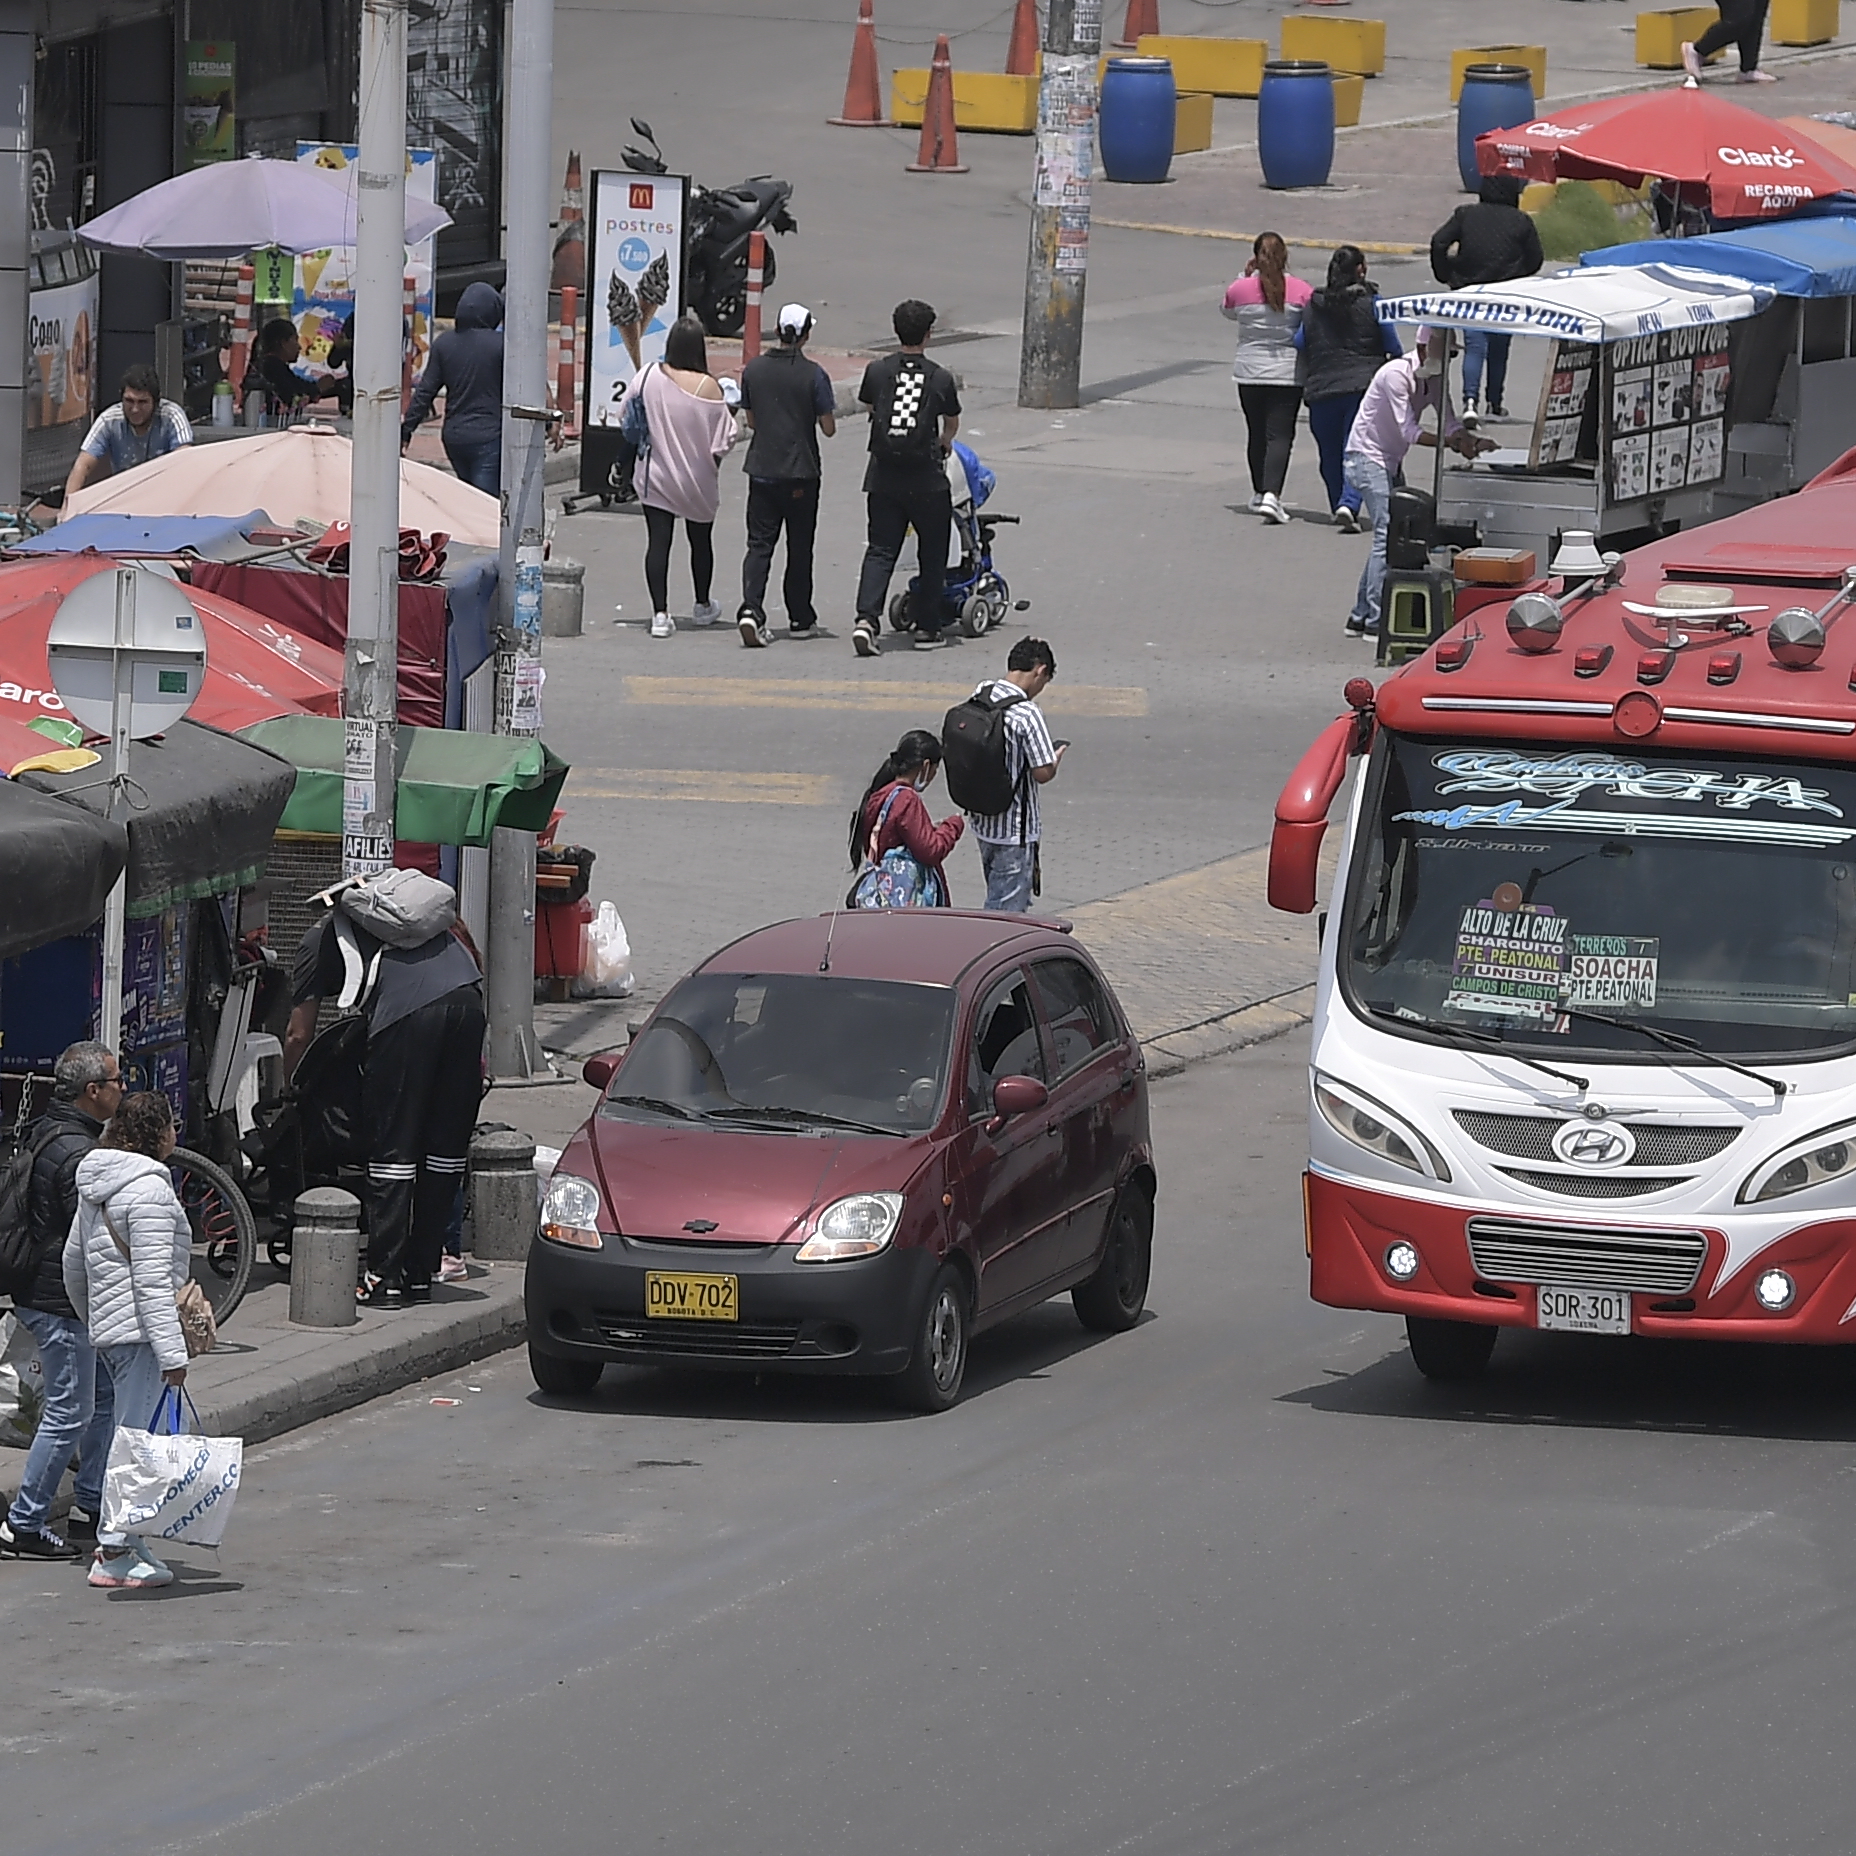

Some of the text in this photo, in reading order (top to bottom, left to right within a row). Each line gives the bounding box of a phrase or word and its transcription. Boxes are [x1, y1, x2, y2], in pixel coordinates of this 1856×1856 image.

[1718, 145, 1799, 171] Claro
[1744, 184, 1813, 200] RECARGA
[606, 217, 674, 237] postres
[1380, 299, 1430, 322] NEW
[1523, 305, 1588, 335] YORK
[1637, 303, 1716, 332] NEW YORK
[30, 315, 61, 348] Cono
[1612, 332, 1663, 369] OPTICA
[1460, 907, 1568, 944] ALTO DE LA CRUZ
[1458, 934, 1564, 955] CHARQUITO
[1456, 944, 1561, 972] PTE. PEATONAL
[1572, 957, 1654, 980] SOACHA
[1477, 965, 1557, 984] UNISUR
[1452, 975, 1557, 1001] CAMPOS DE CRISTO
